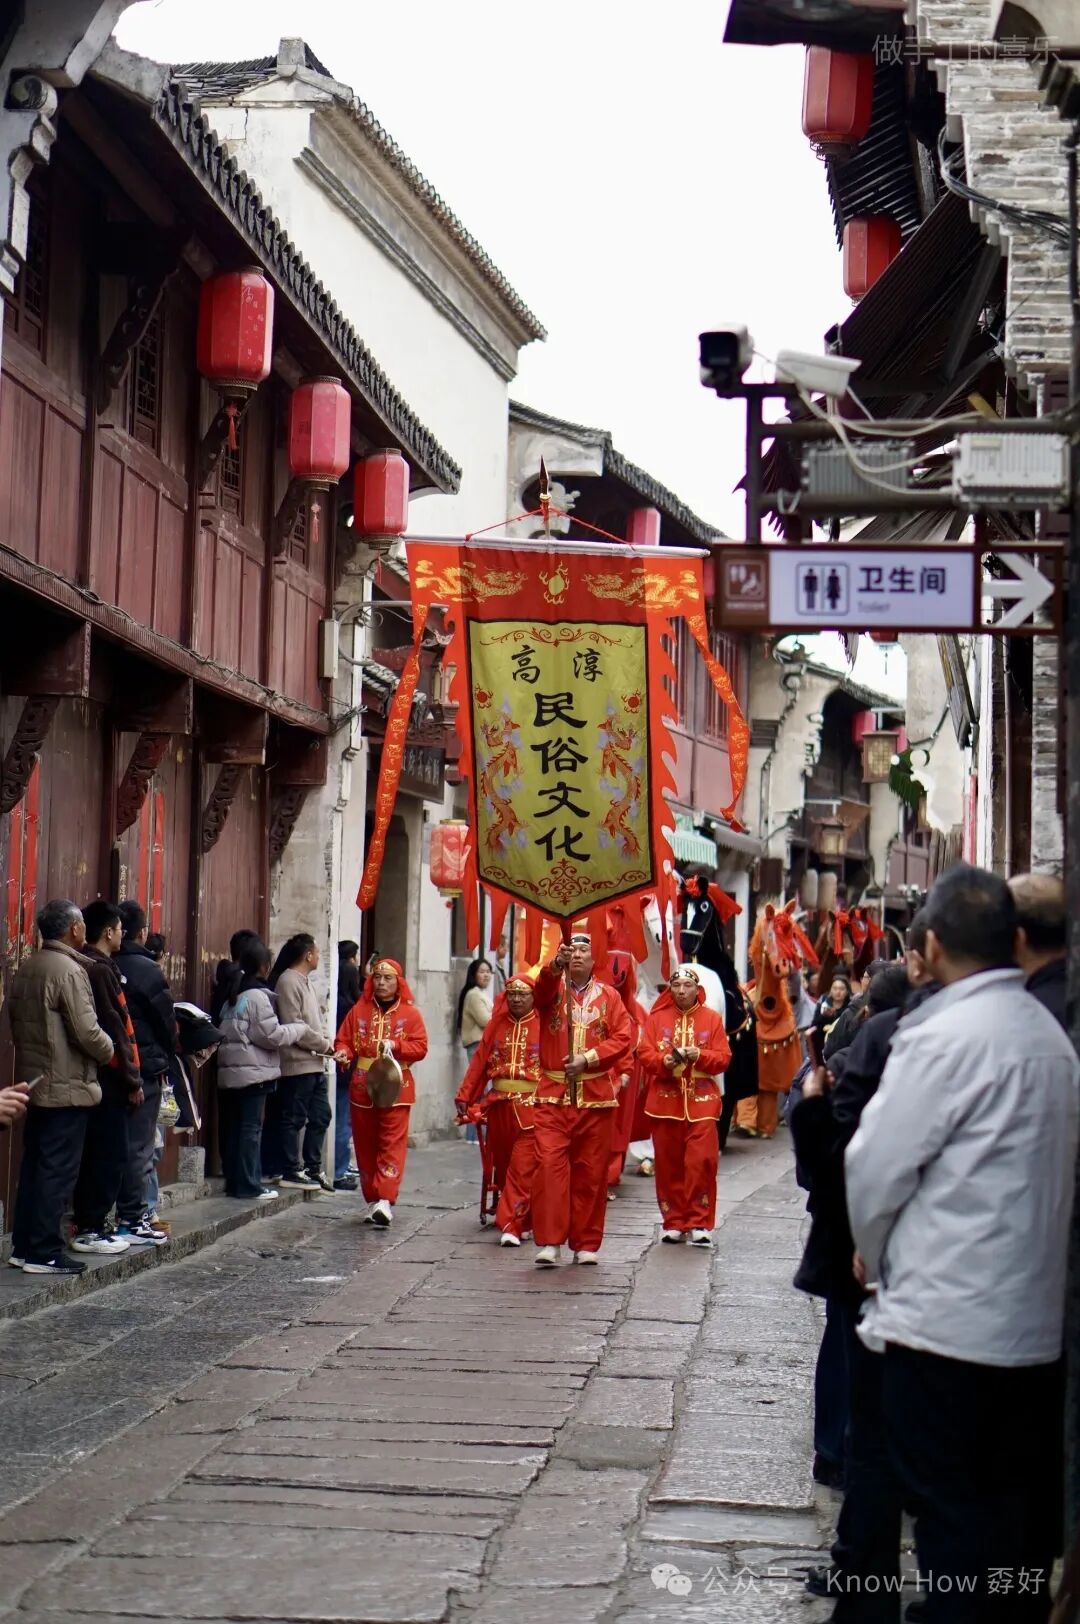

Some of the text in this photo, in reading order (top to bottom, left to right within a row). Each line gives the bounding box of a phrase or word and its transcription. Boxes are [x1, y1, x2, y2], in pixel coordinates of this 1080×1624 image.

[857, 566, 946, 595] 卫生间
[511, 645, 603, 684] 高淳
[530, 692, 591, 862] 民俗文化
